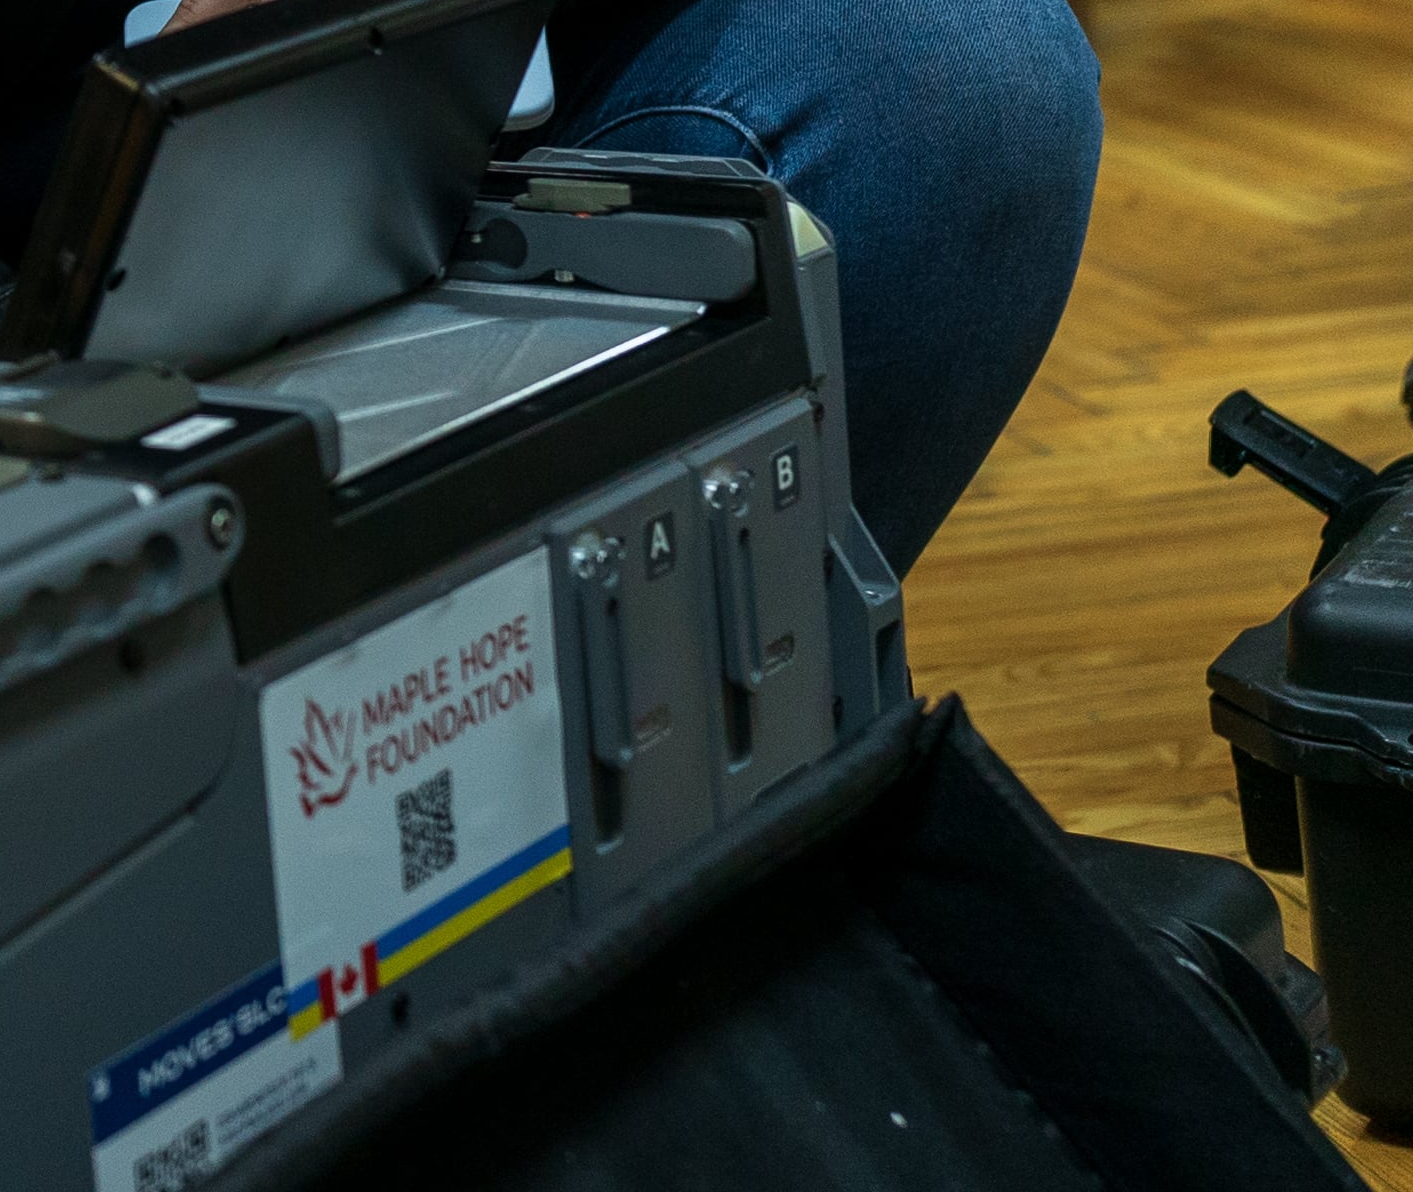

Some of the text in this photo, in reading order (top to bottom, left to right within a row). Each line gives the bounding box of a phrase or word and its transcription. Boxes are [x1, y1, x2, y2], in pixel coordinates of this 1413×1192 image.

[777, 455, 794, 490] B
[651, 522, 670, 559] A
[362, 613, 530, 735] MAPLE HOPE
[365, 660, 535, 784] FOUNDATION
